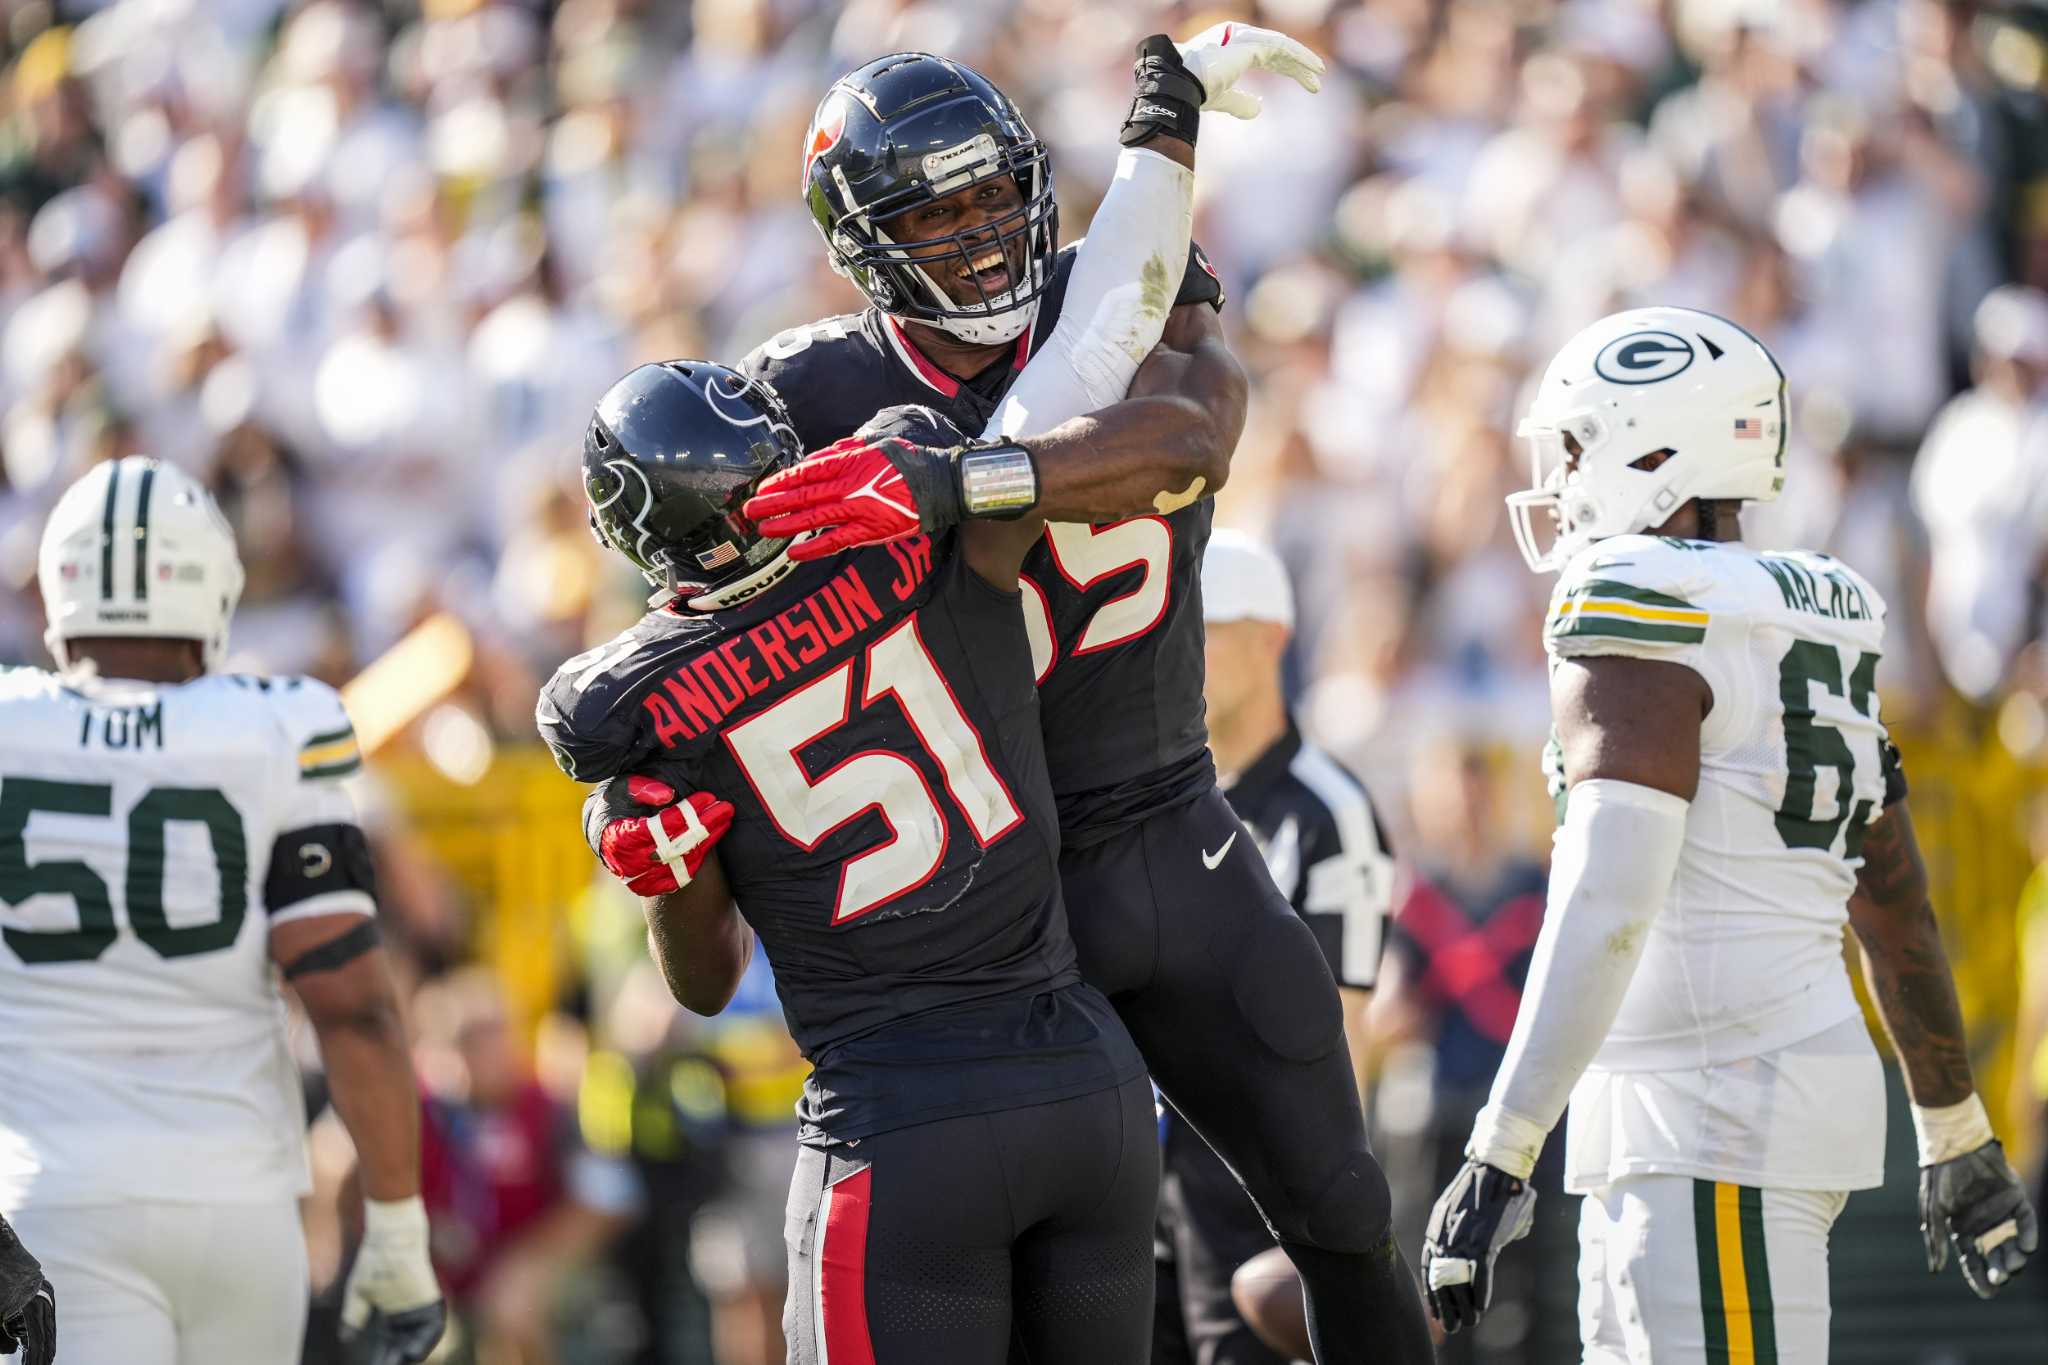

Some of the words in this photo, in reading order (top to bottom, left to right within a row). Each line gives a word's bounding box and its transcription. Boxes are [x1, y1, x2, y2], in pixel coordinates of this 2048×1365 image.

[643, 564, 884, 749] ANDERSON
[719, 609, 1026, 927] 51
[0, 777, 248, 965] 50
